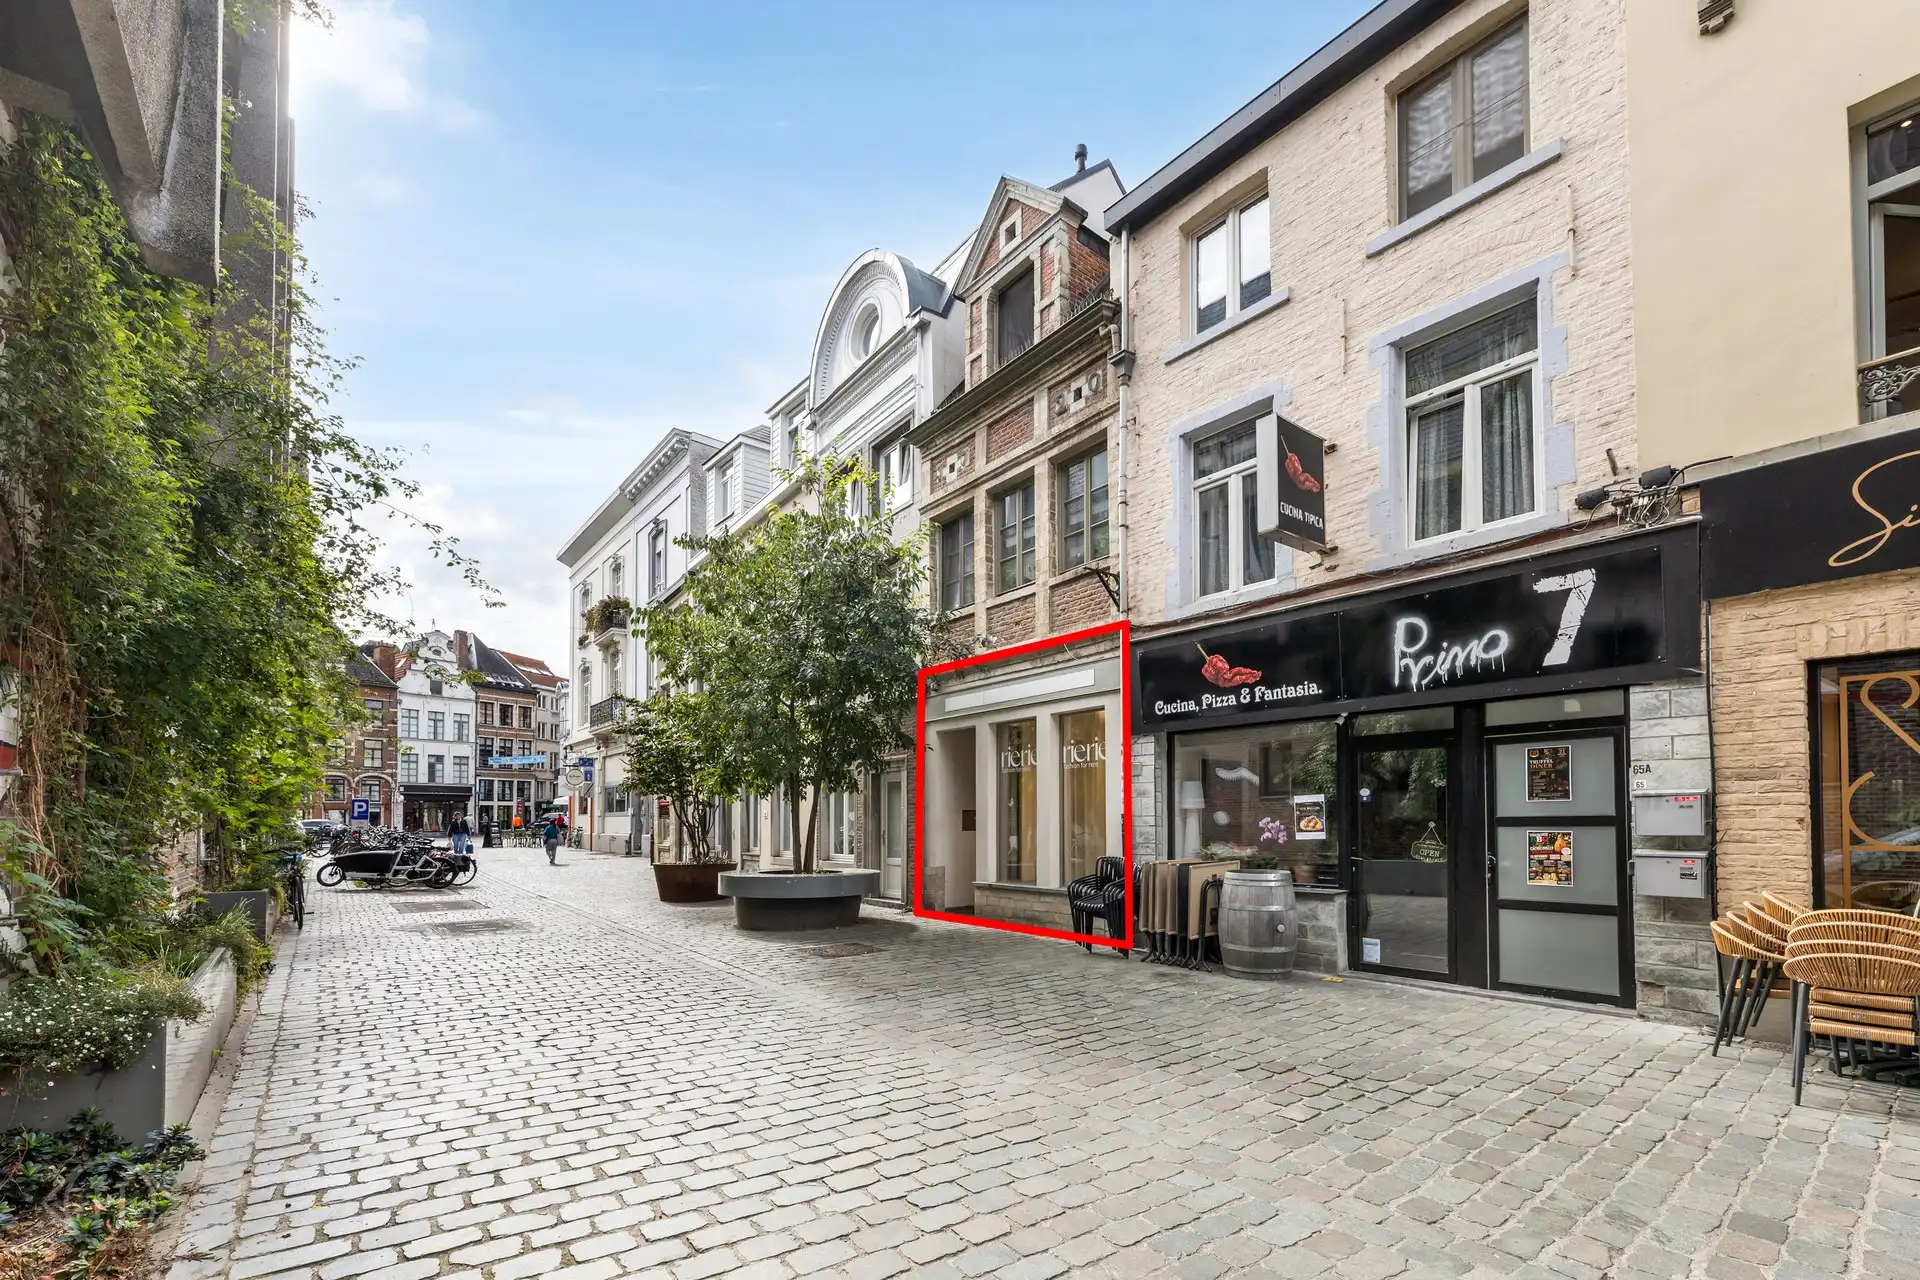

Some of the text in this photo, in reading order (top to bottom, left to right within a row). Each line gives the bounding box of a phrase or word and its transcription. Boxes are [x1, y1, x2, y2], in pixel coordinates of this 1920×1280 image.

[1280, 501, 1324, 530] CUCINA TIPICA
[1393, 567, 1597, 692] Primo 7
[1154, 680, 1323, 716] Cucina, Pizza & Fantasia.
[1632, 764, 1652, 775] 65A
[353, 801, 367, 817] P
[1419, 848, 1440, 857] OPEN
